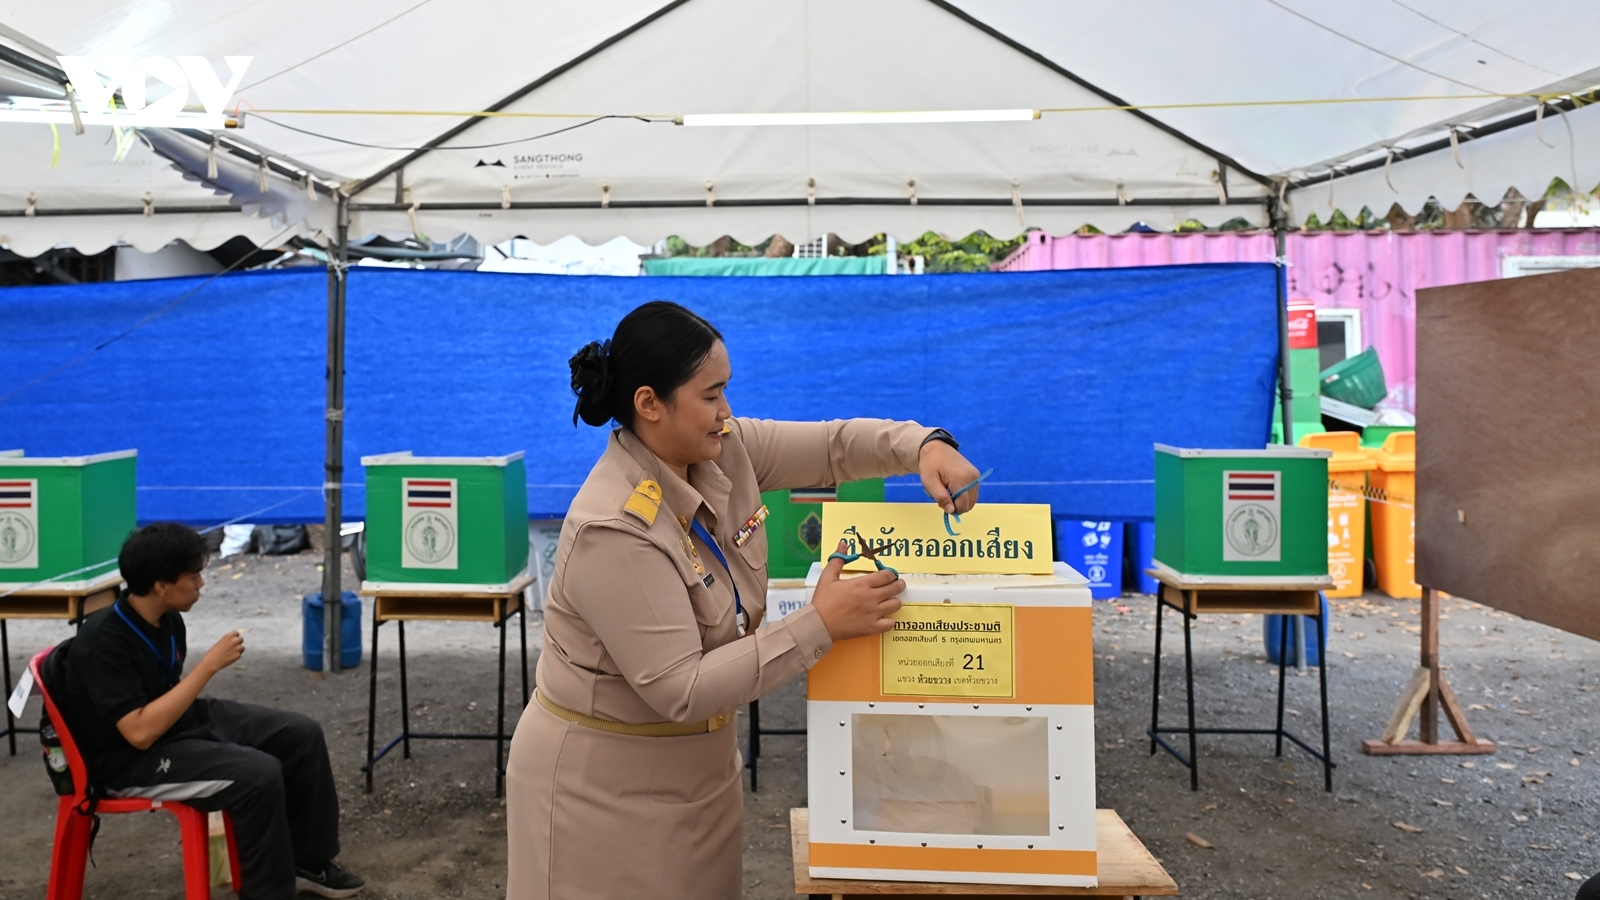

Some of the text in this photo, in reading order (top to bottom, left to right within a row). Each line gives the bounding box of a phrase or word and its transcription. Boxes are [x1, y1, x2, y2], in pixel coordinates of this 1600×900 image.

[513, 153, 584, 164] SANGTHONG
[893, 620, 1001, 632] การออกเสียงประชามติ
[892, 634, 938, 643] เขตออกเสียงที่
[950, 636, 1002, 645] กรุงเทพมหานคร
[898, 653, 985, 670] หน่วยออกเสียงที่ 21
[897, 675, 915, 683] แขวง
[917, 673, 952, 684] ห้วยขวาง
